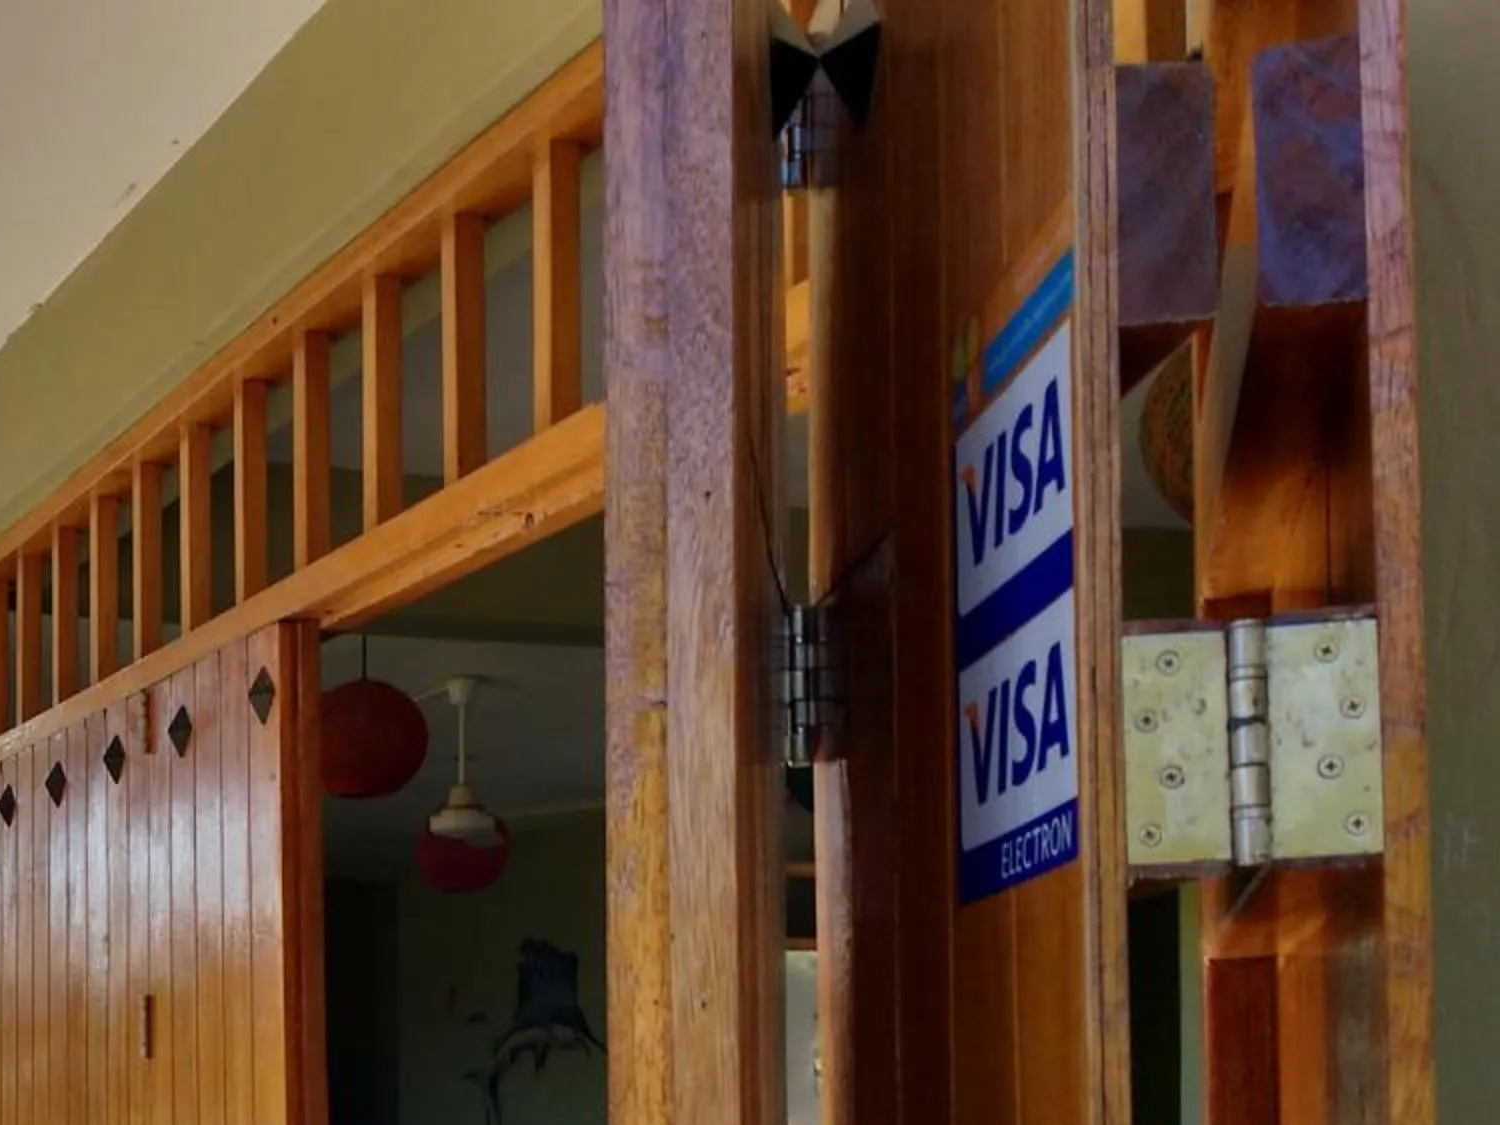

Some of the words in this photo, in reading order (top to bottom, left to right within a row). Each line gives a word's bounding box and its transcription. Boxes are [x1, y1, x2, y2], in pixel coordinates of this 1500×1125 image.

[960, 375, 1066, 568] VISA
[964, 641, 1070, 805] VISA
[1002, 810, 1073, 879] ELECTRON
